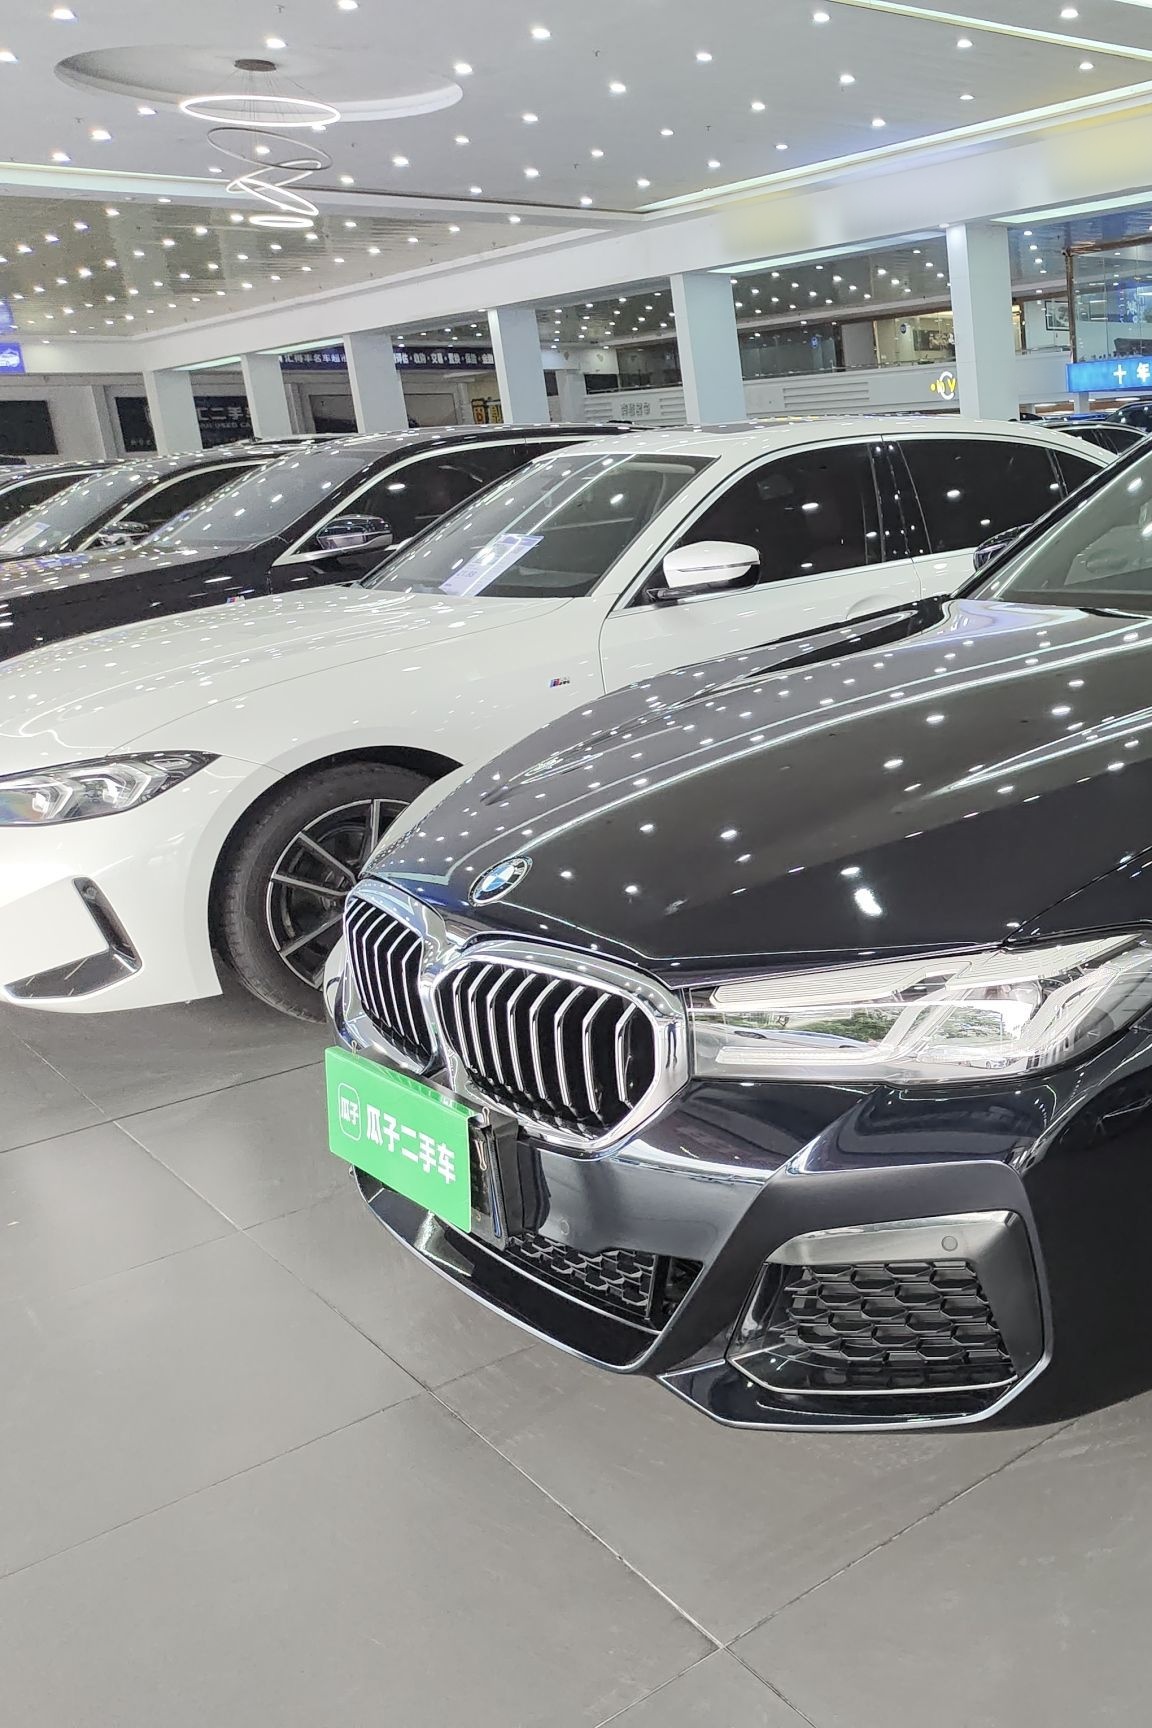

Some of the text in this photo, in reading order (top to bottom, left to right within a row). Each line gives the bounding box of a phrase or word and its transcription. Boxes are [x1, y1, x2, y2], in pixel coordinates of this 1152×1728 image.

[341, 1097, 359, 1126] 瓜子
[366, 1104, 456, 1184] 瓜子二手车
